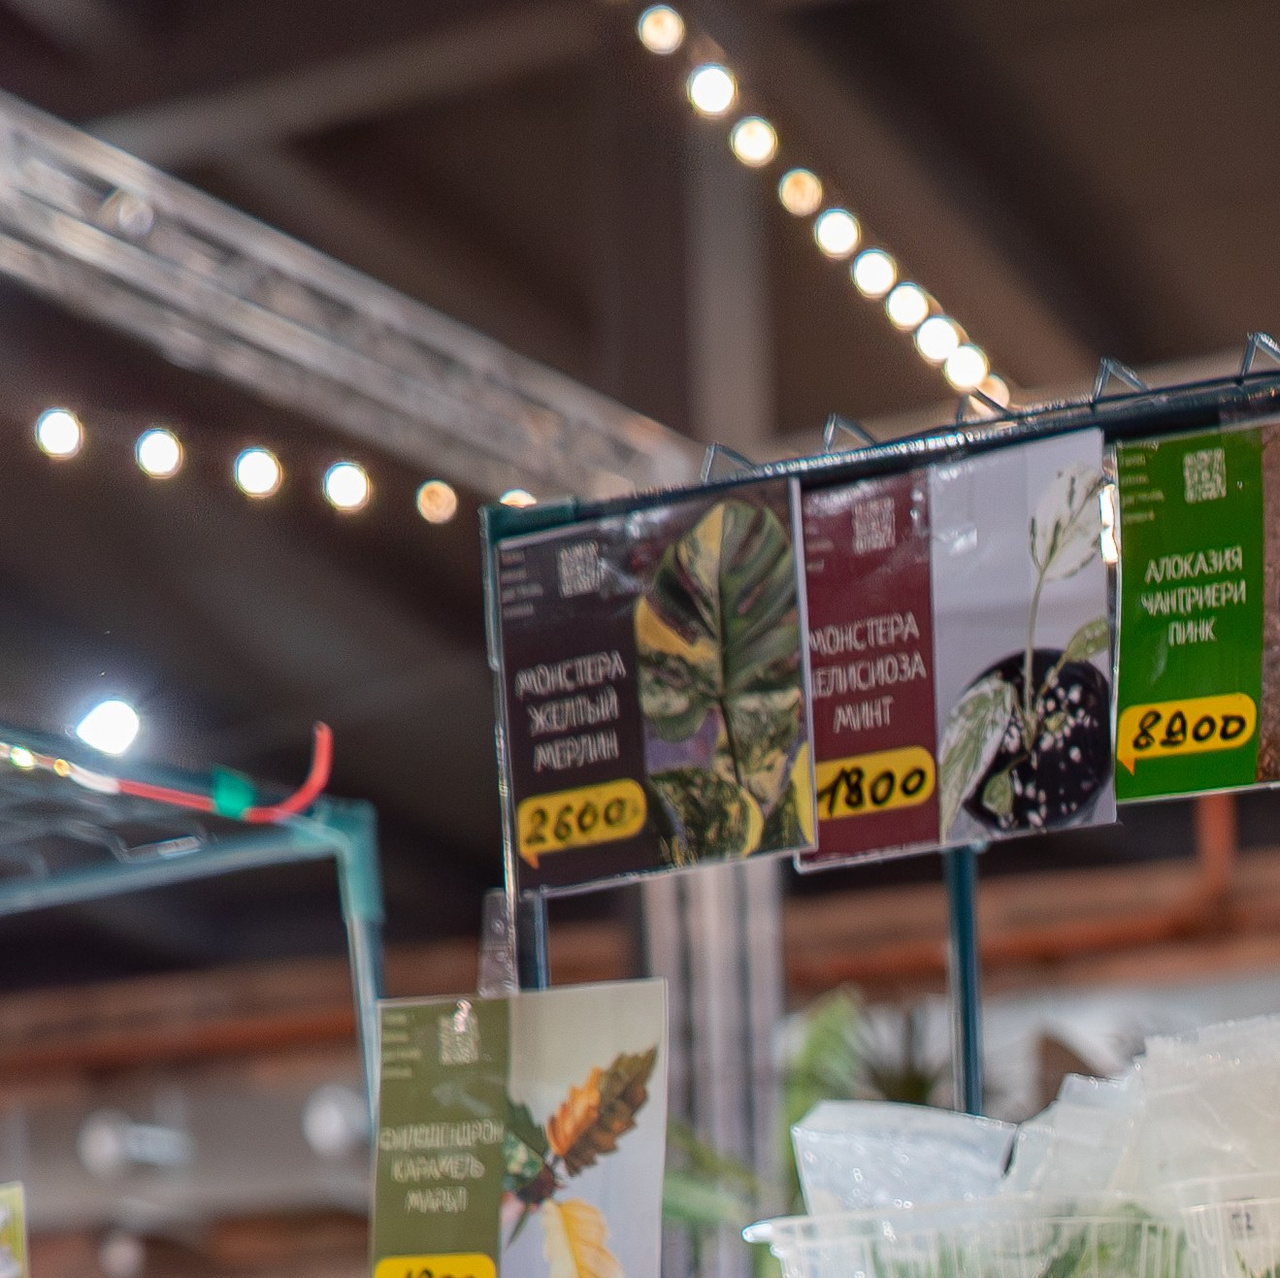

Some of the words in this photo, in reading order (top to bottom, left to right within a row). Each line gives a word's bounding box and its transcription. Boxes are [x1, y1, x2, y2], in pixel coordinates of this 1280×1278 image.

[1144, 546, 1243, 584] АЛОКАЗИЯ
[809, 611, 920, 655] МОНСТЕРА
[1167, 617, 1216, 646] ПИНК
[515, 650, 626, 699] МОНСТЕРА
[834, 695, 893, 733] МИНТ
[1133, 709, 1247, 750] 8900
[817, 765, 927, 818] 1800
[526, 796, 627, 845] 2600
